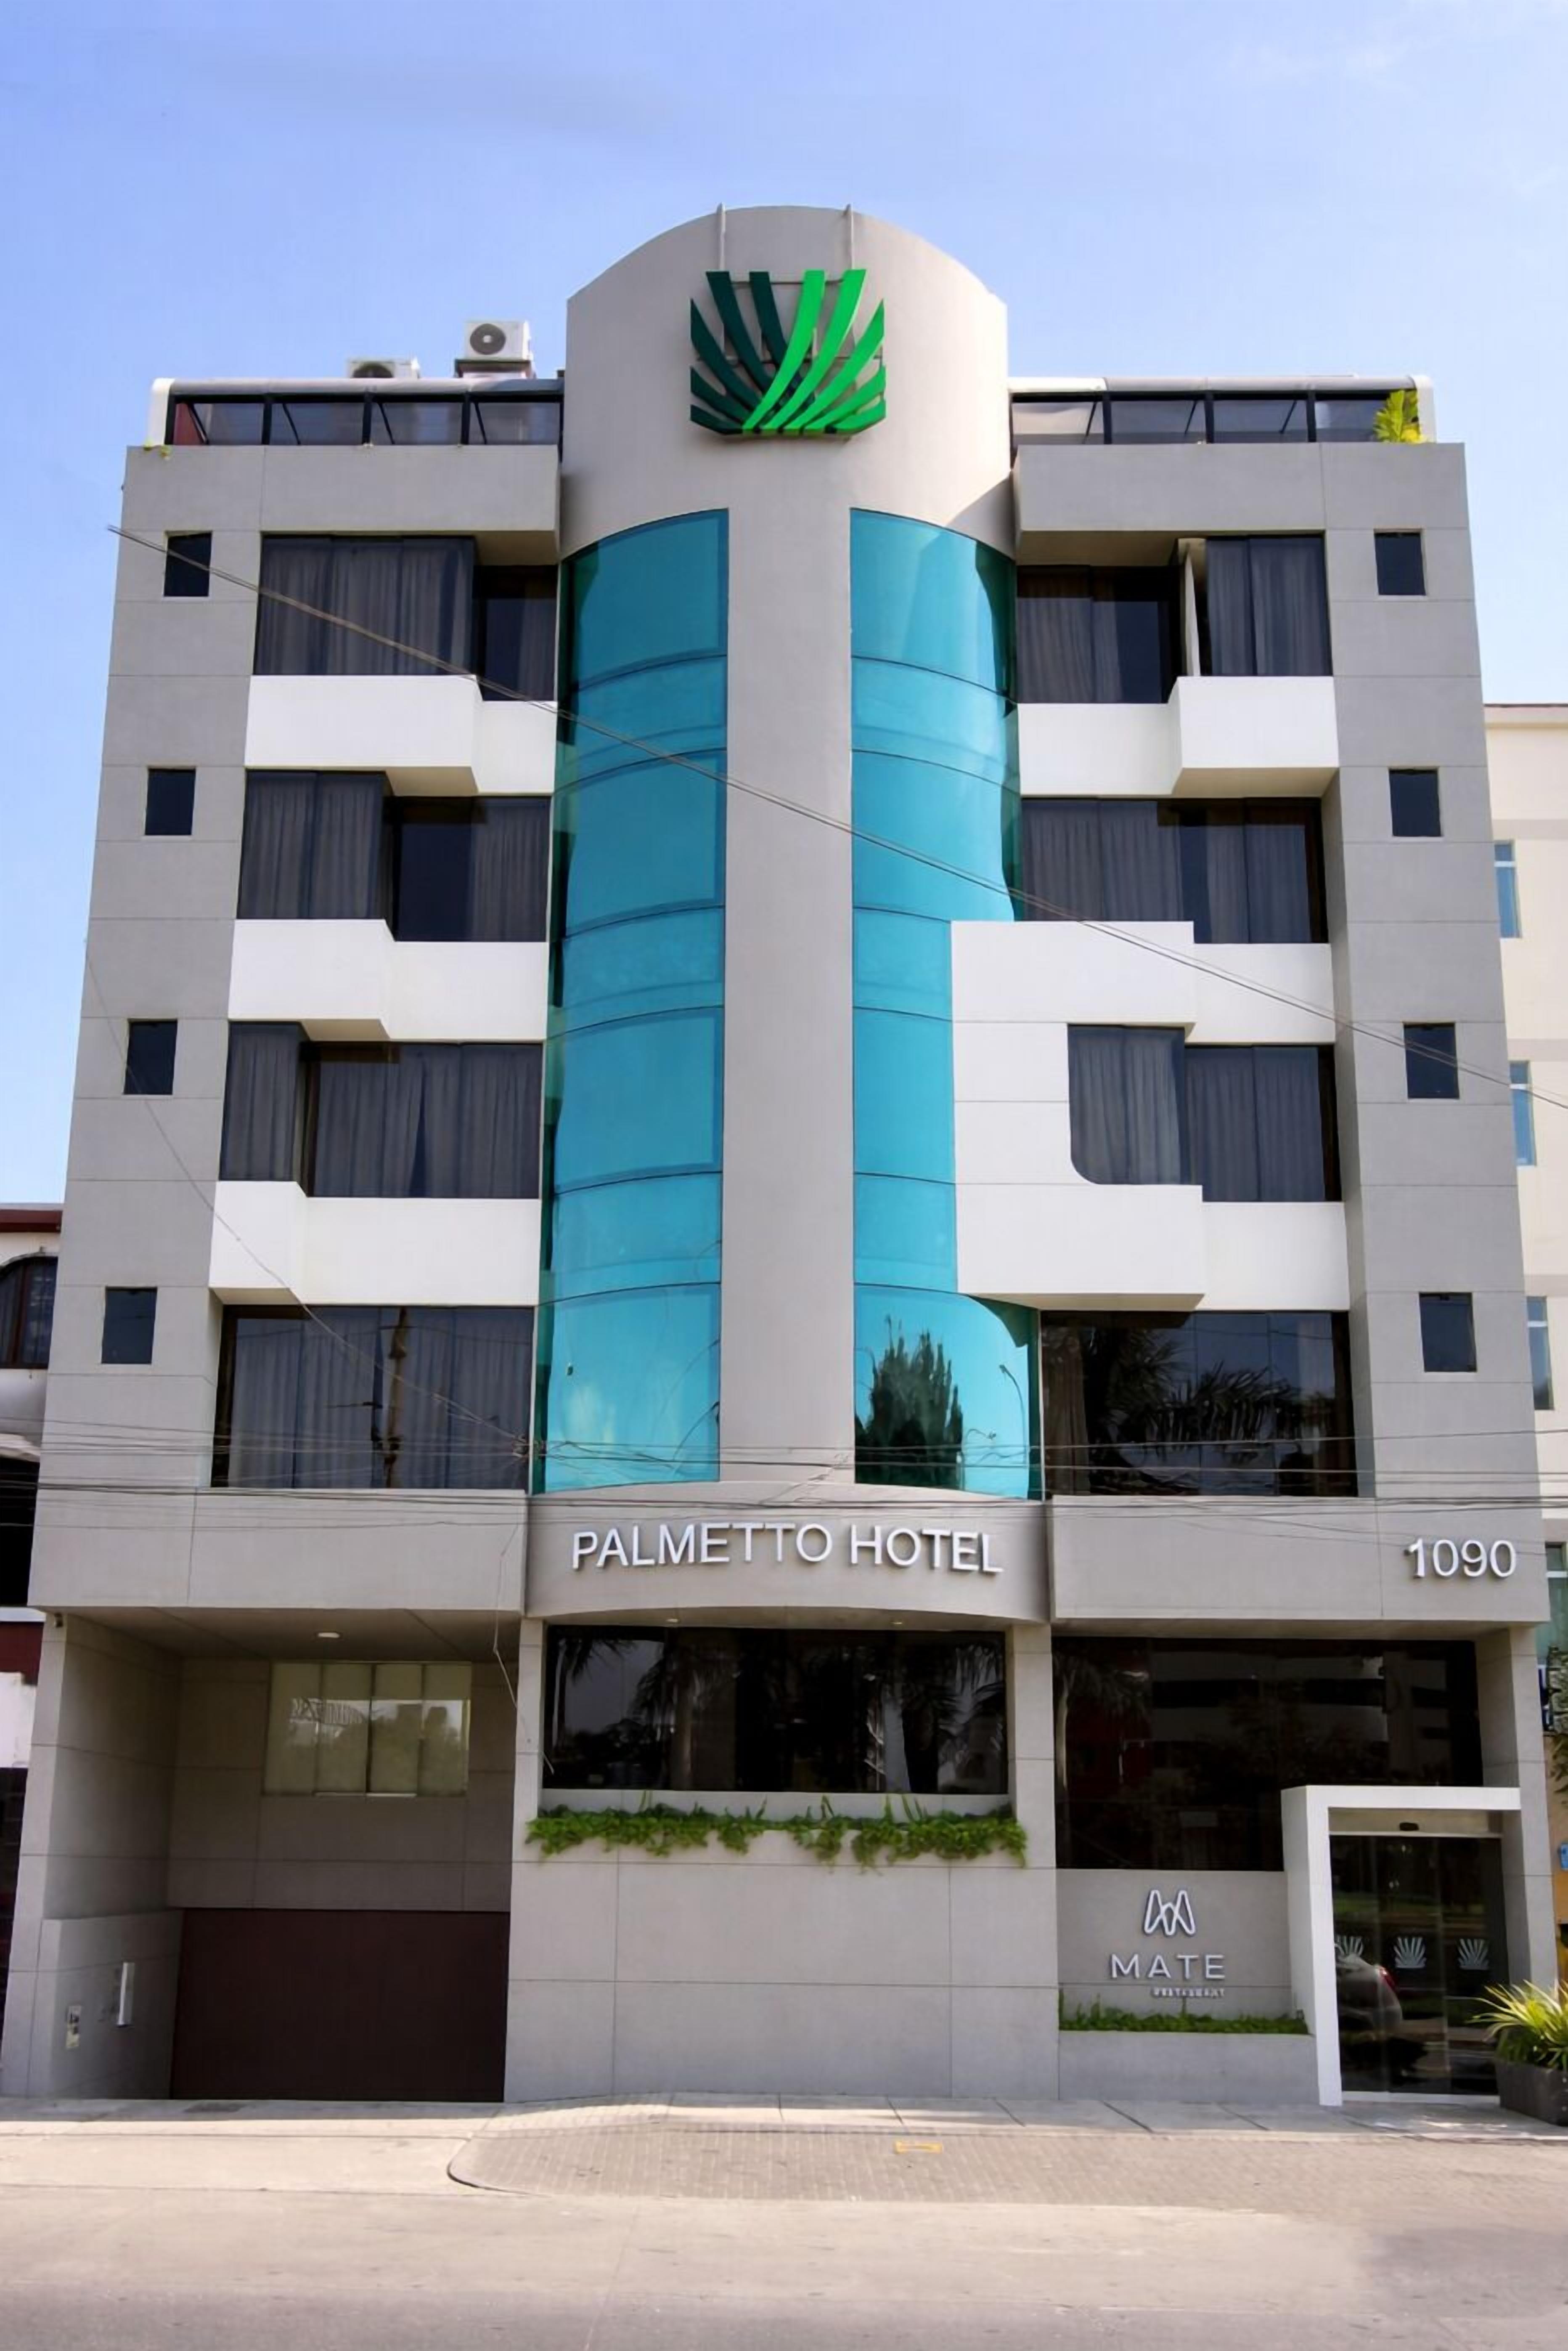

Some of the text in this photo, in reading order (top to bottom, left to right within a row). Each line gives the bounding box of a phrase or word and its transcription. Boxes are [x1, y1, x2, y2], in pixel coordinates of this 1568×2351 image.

[572, 1523, 1003, 1573] PALMETTO HOTEL
[1406, 1538, 1517, 1578] 1090
[1110, 1953, 1226, 1979] MATE
